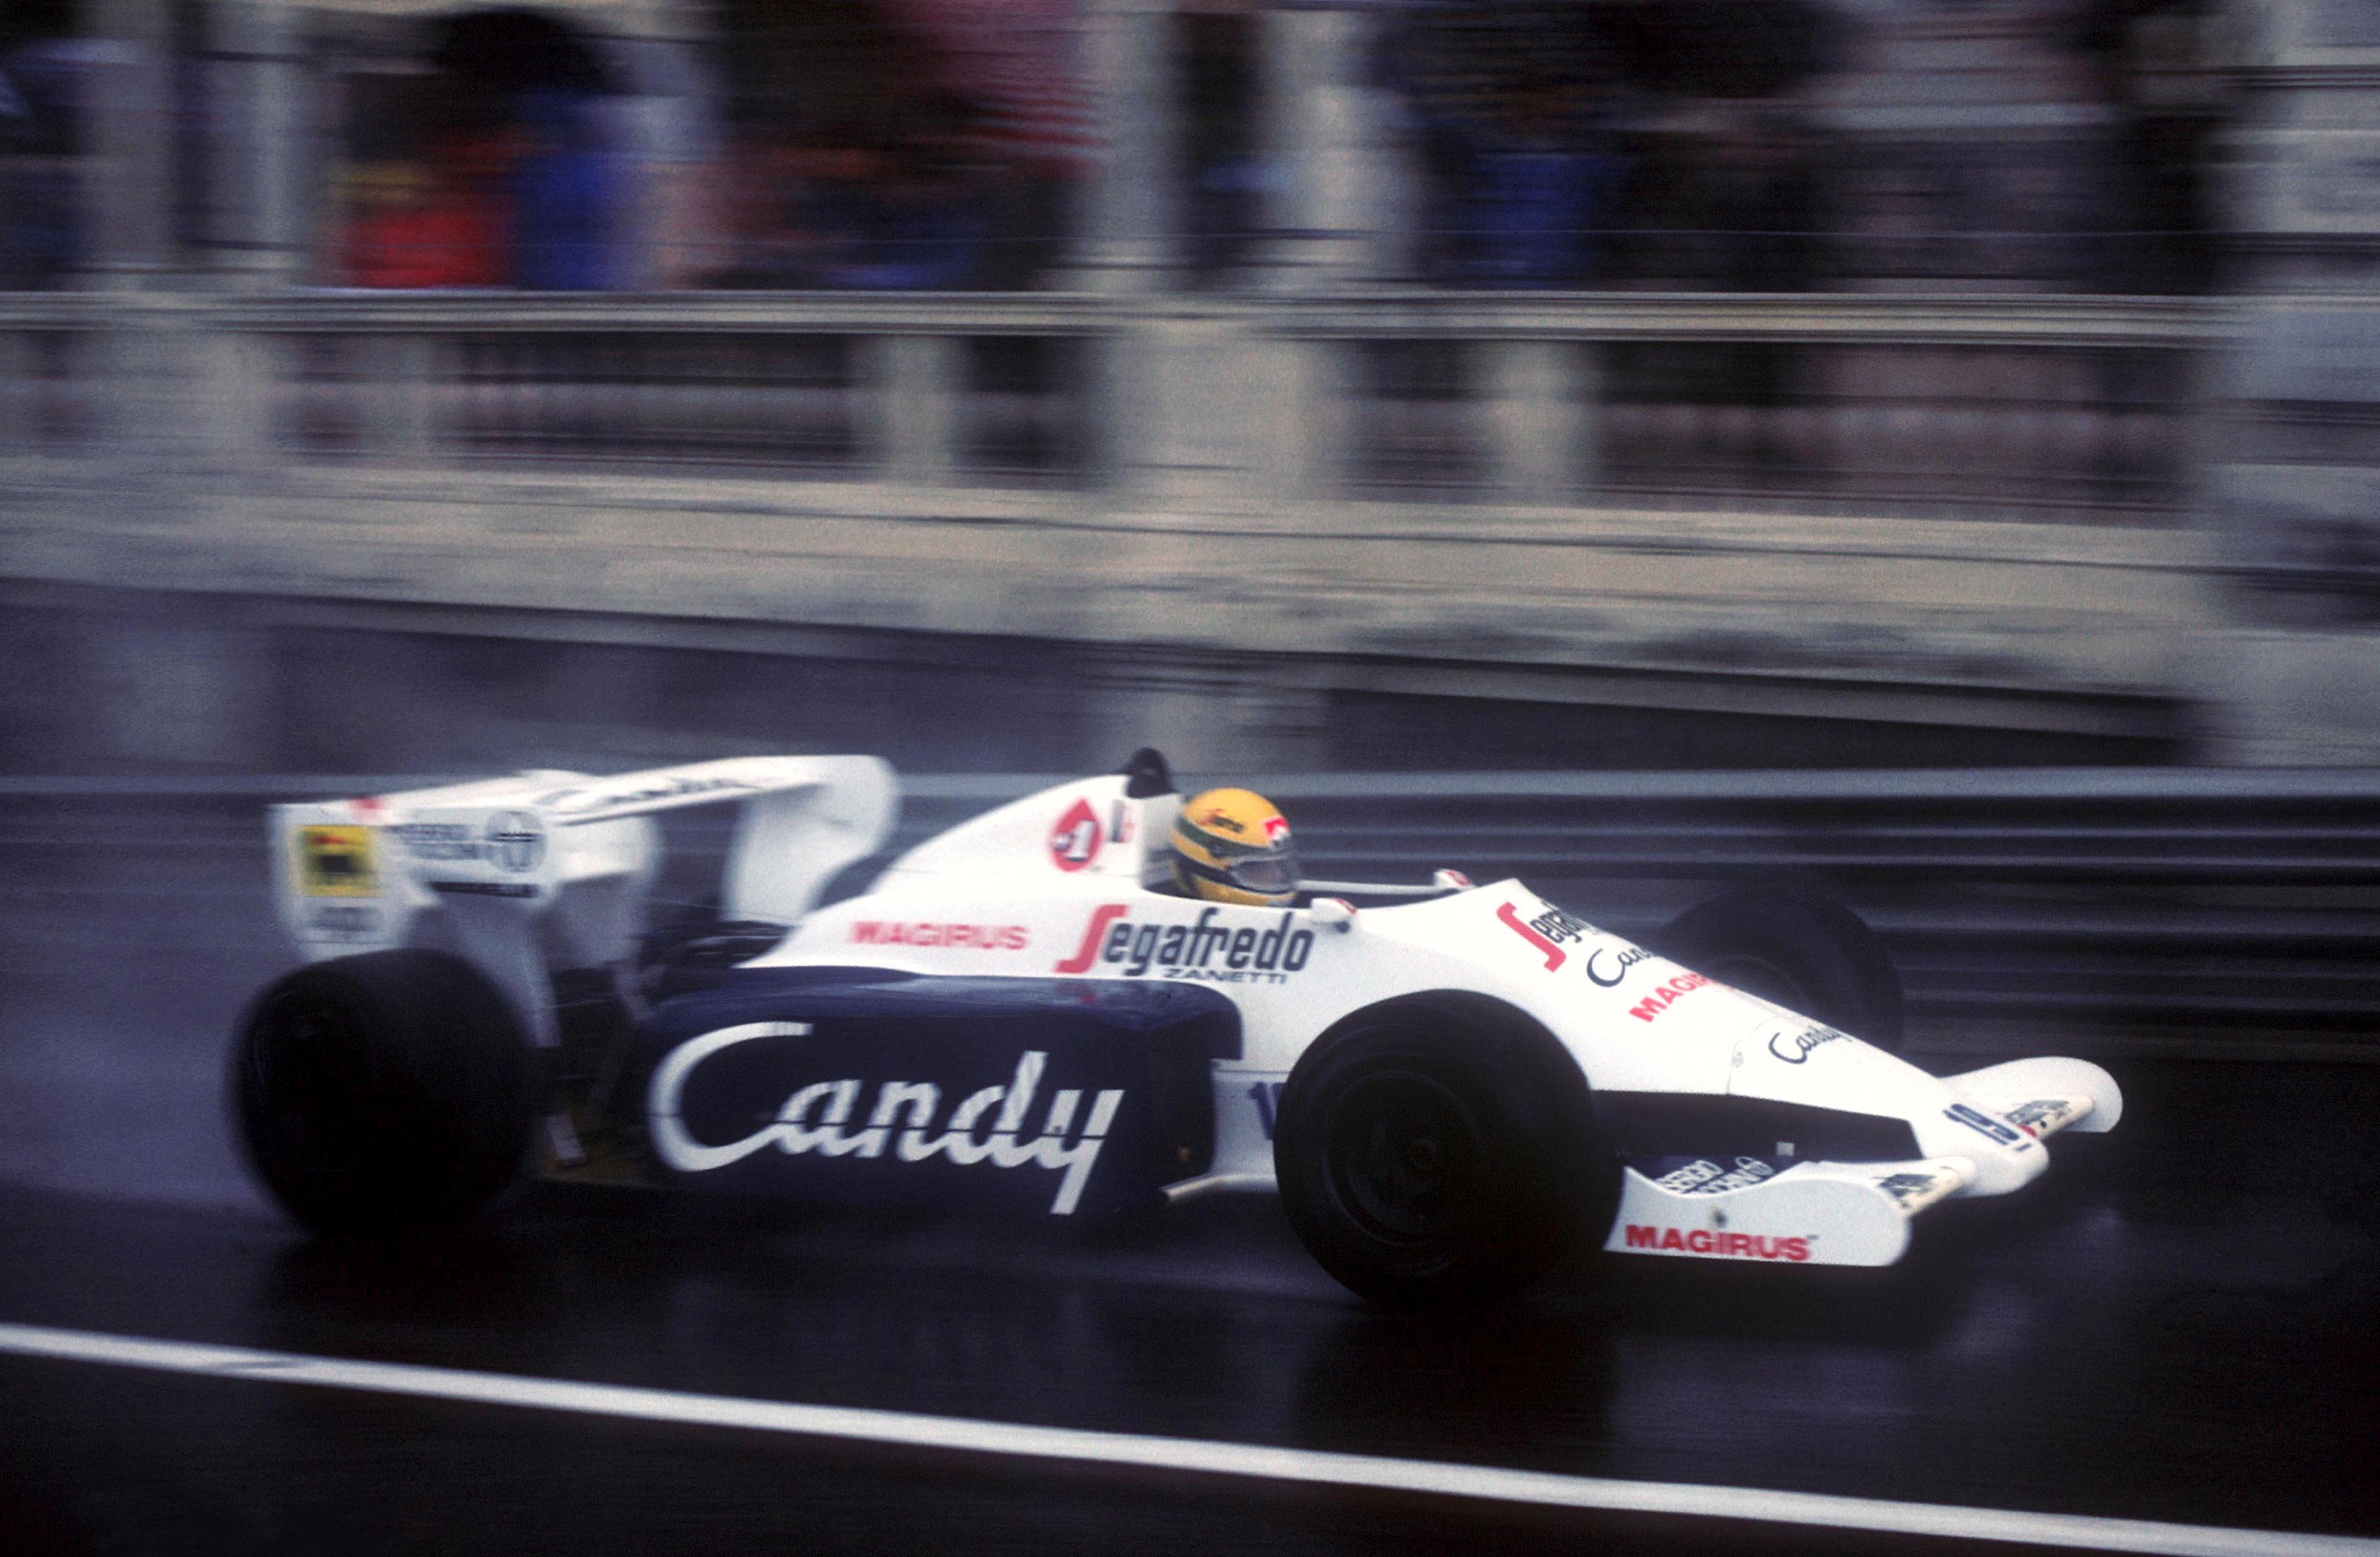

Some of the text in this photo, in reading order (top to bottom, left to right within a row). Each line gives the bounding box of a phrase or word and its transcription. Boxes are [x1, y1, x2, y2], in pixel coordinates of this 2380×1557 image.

[850, 920, 1029, 950] MAGIRUS
[1054, 903, 1314, 976] Segafredo
[1161, 967, 1287, 985] ZANETTI
[649, 1020, 1126, 1215] Candy
[1625, 1224, 1810, 1262] MAGIRUS
